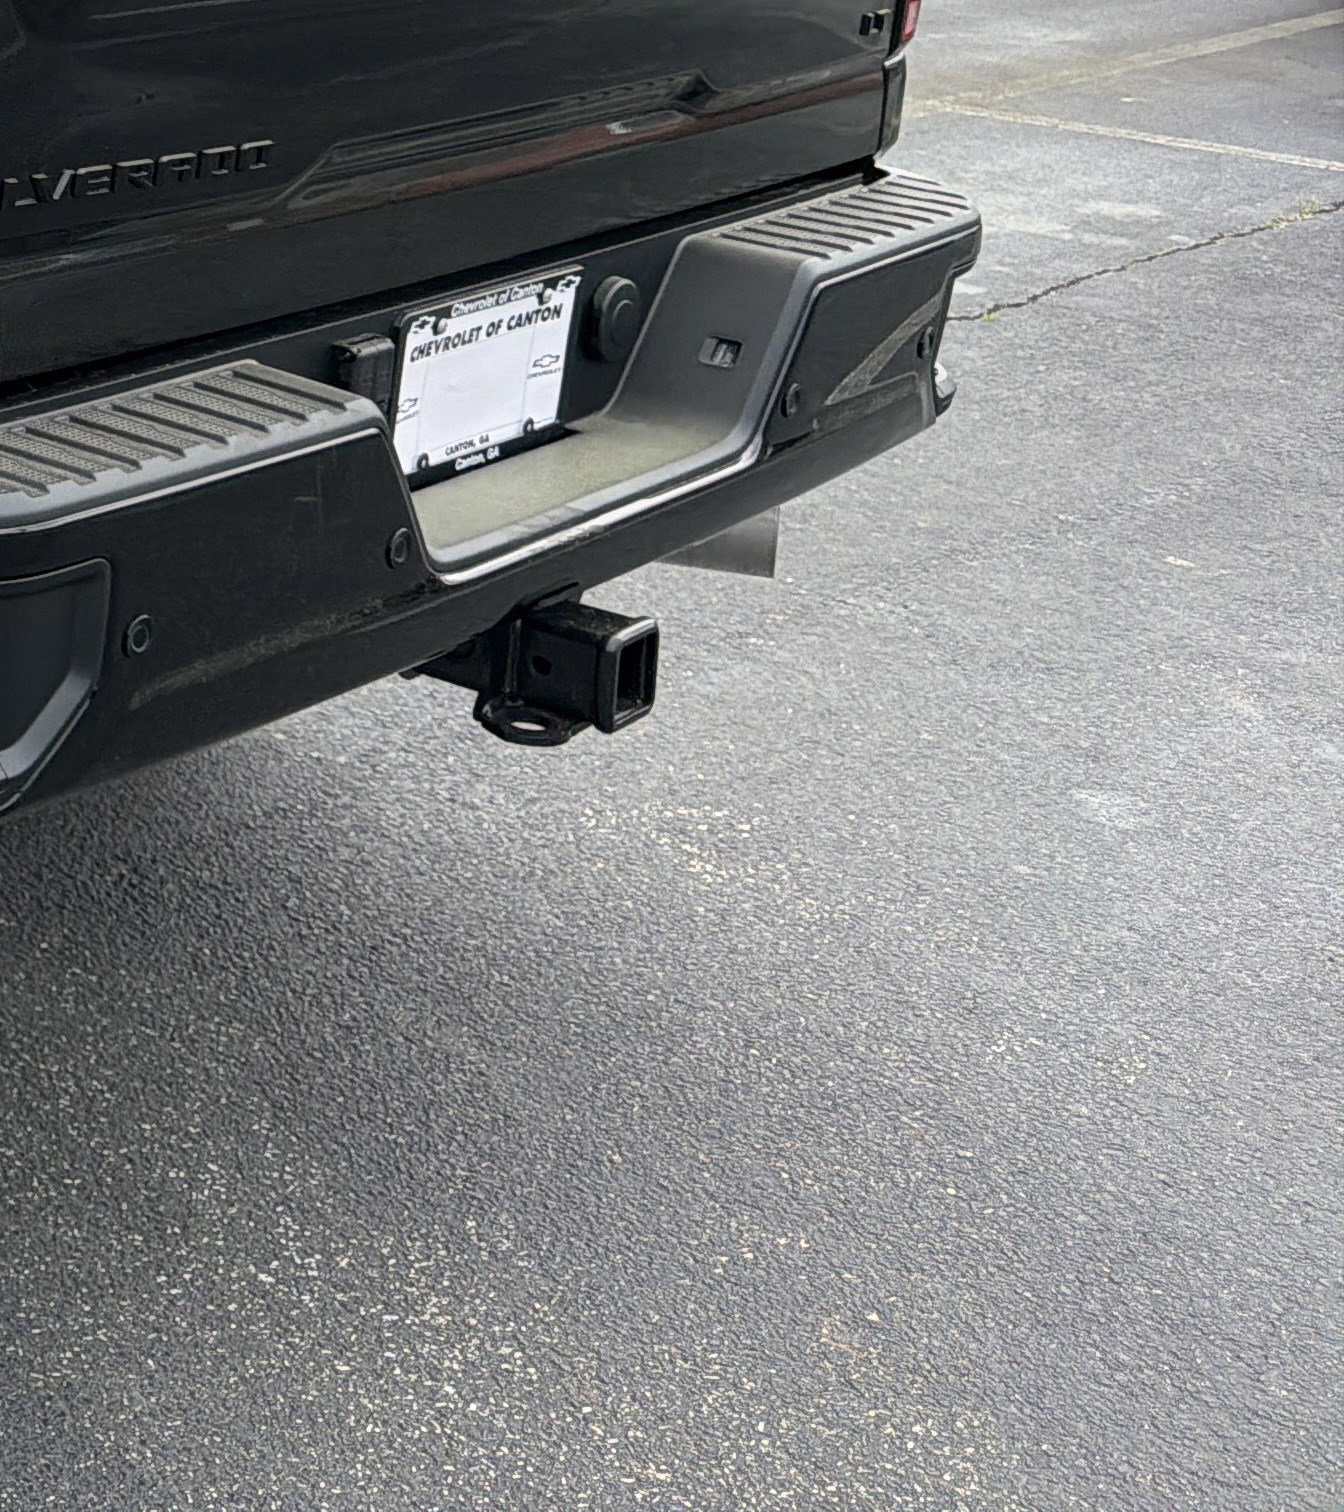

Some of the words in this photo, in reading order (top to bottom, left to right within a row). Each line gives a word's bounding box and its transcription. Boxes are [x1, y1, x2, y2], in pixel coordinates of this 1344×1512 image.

[410, 325, 483, 363] CHEVROLET
[486, 319, 504, 338] OF
[507, 303, 563, 331] CANTON
